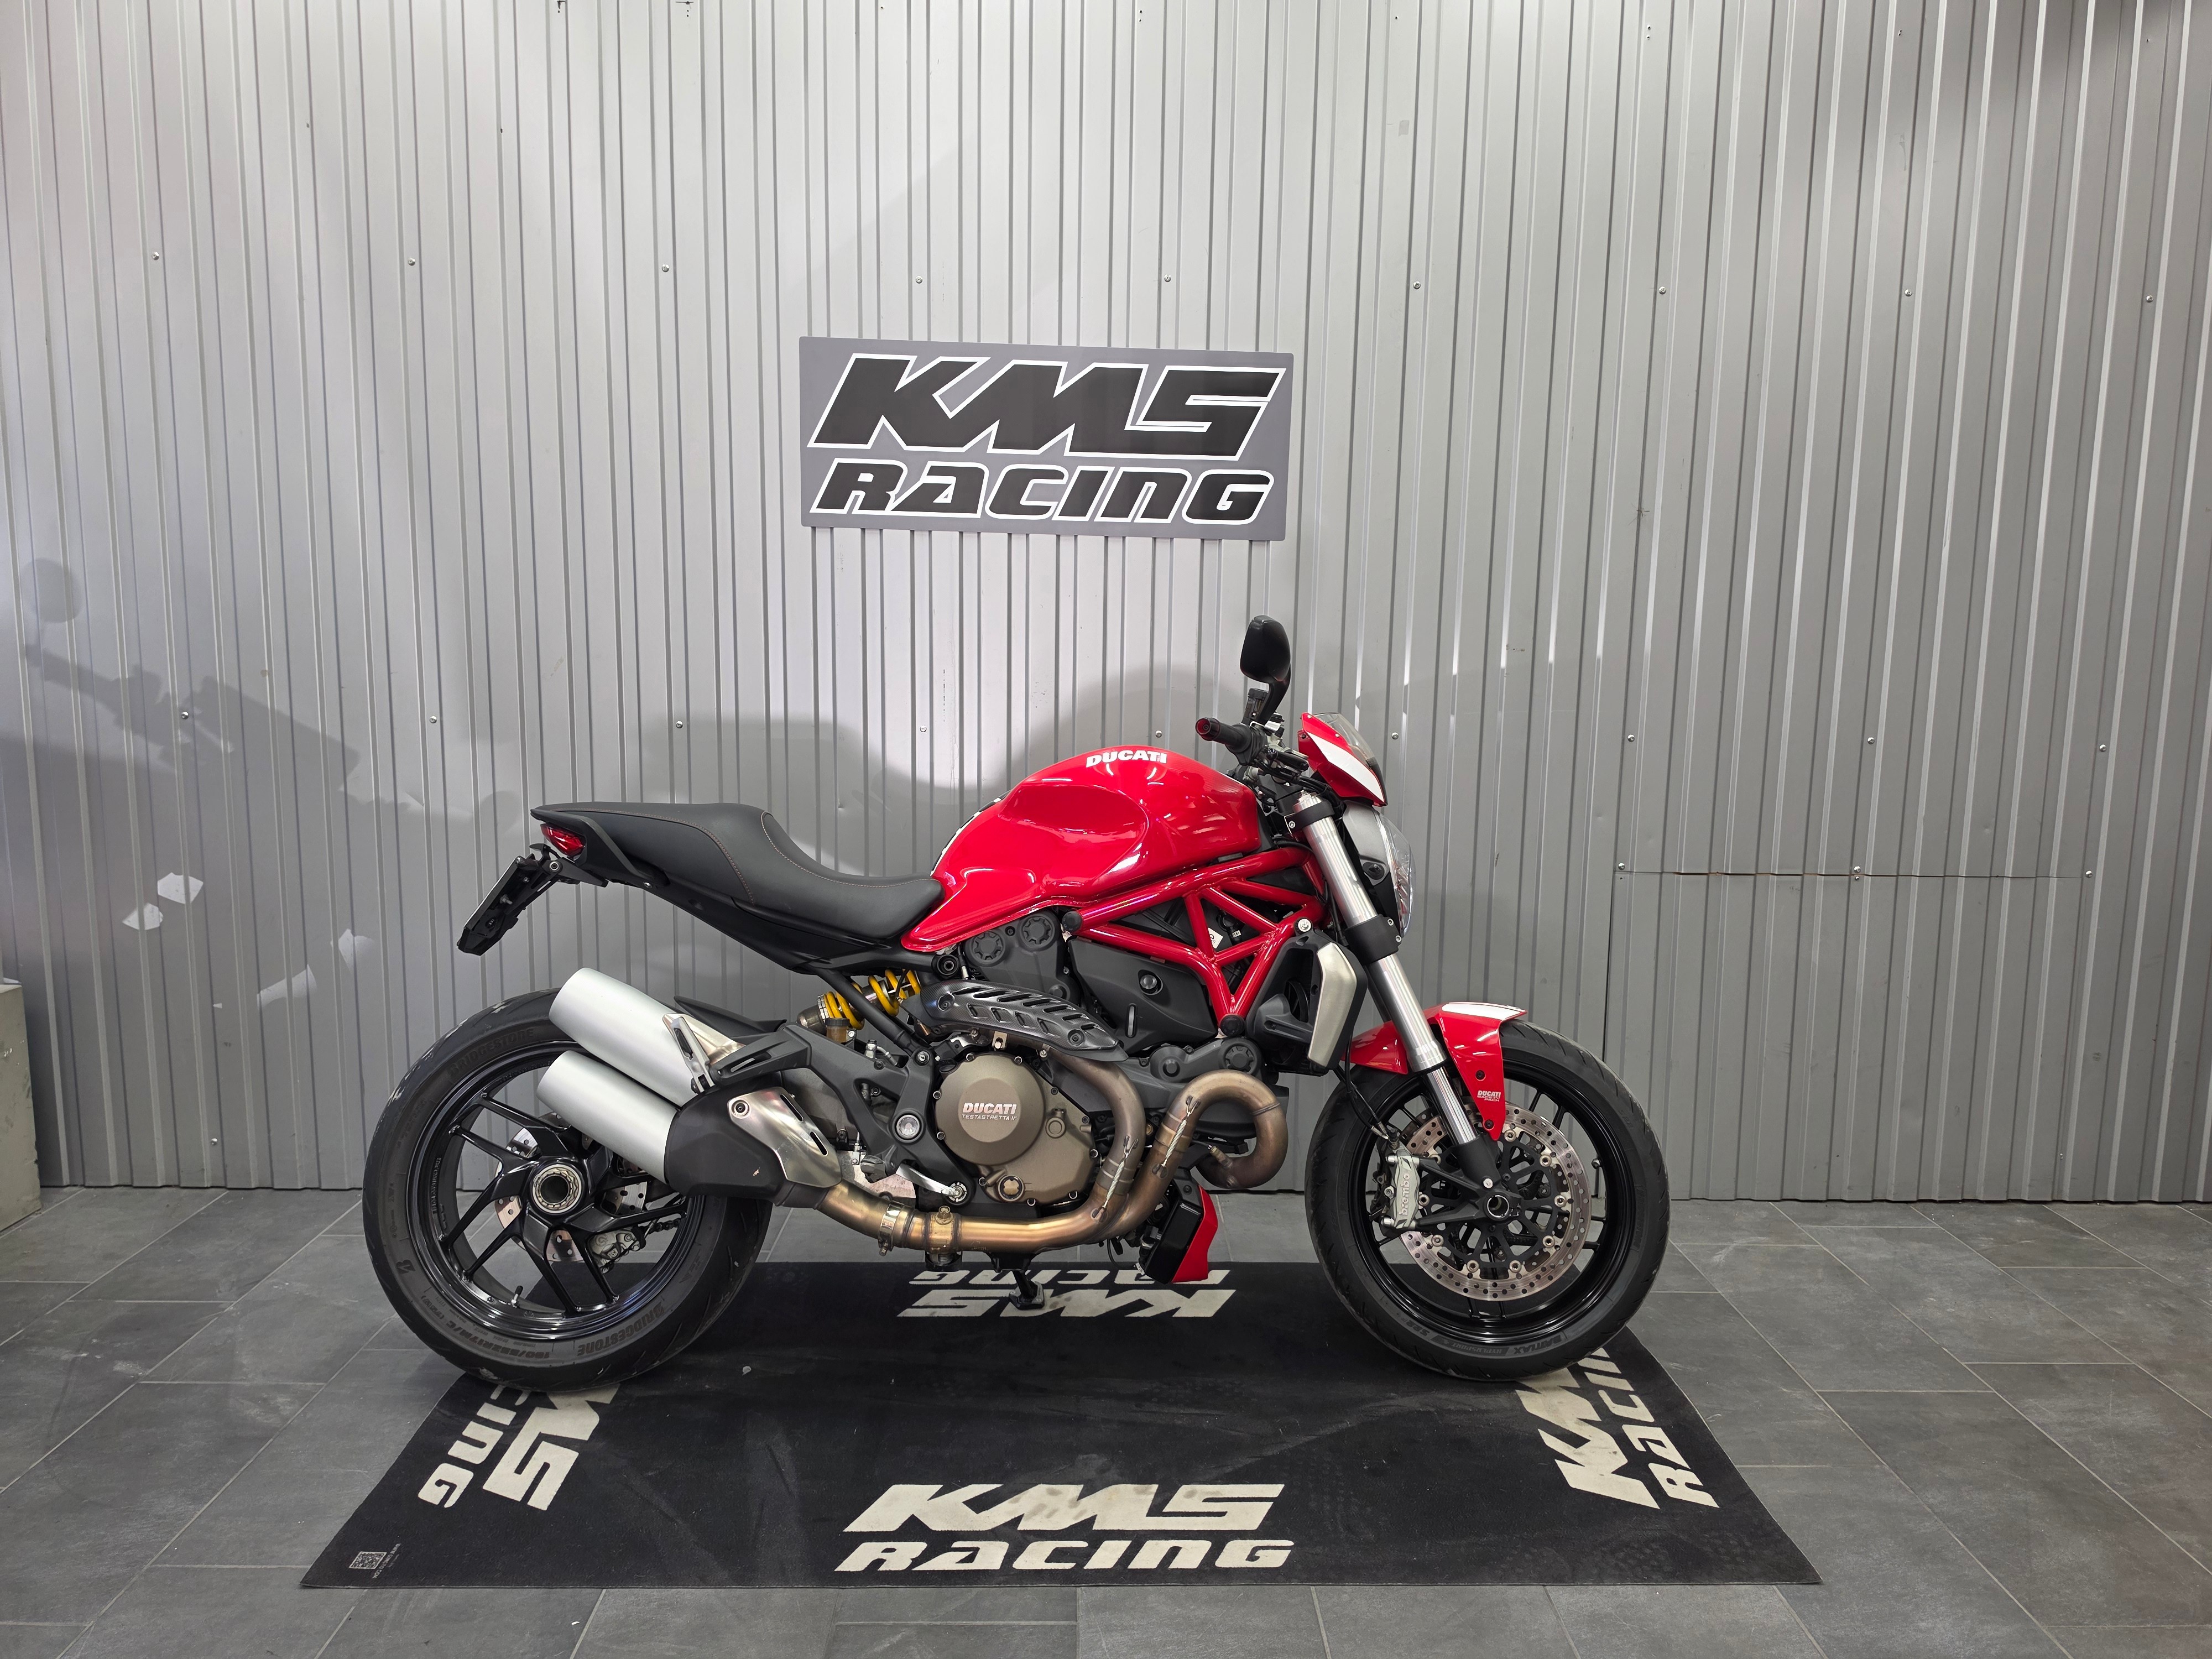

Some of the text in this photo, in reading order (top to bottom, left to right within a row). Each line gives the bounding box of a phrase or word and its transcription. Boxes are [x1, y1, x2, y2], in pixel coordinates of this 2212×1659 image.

[807, 353, 1286, 461] KMS
[810, 458, 1275, 525] RACING
[1086, 750, 1167, 768] DUCATI
[962, 1102, 1017, 1114] DUCATI
[1399, 1172, 1410, 1215] brembo
[896, 1289, 1236, 1317] KMS
[577, 1302, 664, 1356] BRIDGESTONE
[1513, 1331, 1562, 1354] BATTLAX
[843, 1484, 1285, 1531] KMS
[834, 1540, 1295, 1572] RACING
